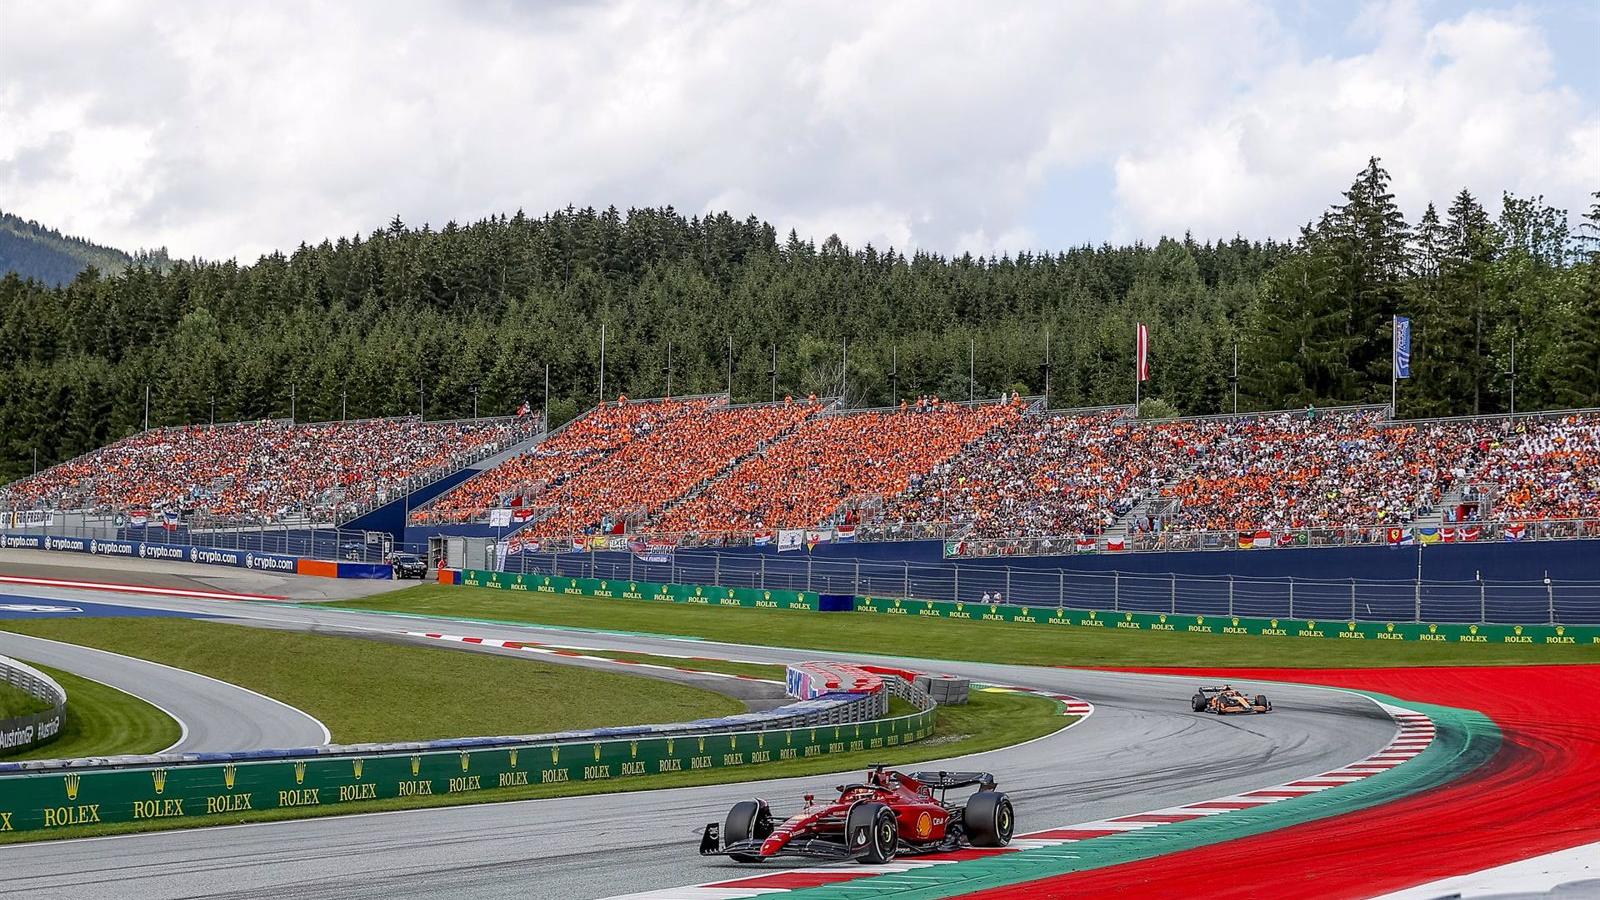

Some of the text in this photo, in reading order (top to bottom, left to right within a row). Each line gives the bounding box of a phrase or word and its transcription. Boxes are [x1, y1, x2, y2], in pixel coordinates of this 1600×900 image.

[7, 537, 38, 547] crypto.com
[52, 538, 83, 550] crypto.com
[98, 542, 132, 553] crypto.com
[146, 546, 182, 558] crypto.com
[198, 551, 236, 563] crypto.com
[254, 557, 293, 569] crypto.com
[486, 581, 501, 589] ROLEX
[688, 596, 708, 604] ROLEX
[720, 598, 740, 606] ROLEX
[756, 600, 777, 608] ROLEX
[1118, 621, 1139, 629] ROLEX
[1152, 623, 1174, 631] ROLEX
[1378, 632, 1403, 640] ROLEX
[1505, 636, 1532, 644] ROLEX
[780, 749, 797, 761] ROLEX
[805, 745, 820, 756] ROLEX
[691, 756, 712, 768] ROLEX
[724, 753, 742, 766] ROLEX
[752, 751, 770, 763] ROLEX
[621, 762, 645, 776] ROLEX
[660, 759, 681, 772] ROLEX
[542, 768, 569, 783] ROLEX
[584, 766, 609, 779] ROLEX
[449, 777, 480, 791] ROLEX
[500, 772, 528, 787] ROLEX
[340, 783, 376, 801] ROLEX
[399, 780, 432, 796] ROLEX
[207, 793, 252, 813] ROLEX
[279, 788, 319, 807] ROLEX
[134, 799, 183, 818] ROLEX
[44, 804, 100, 826] ROLEX
